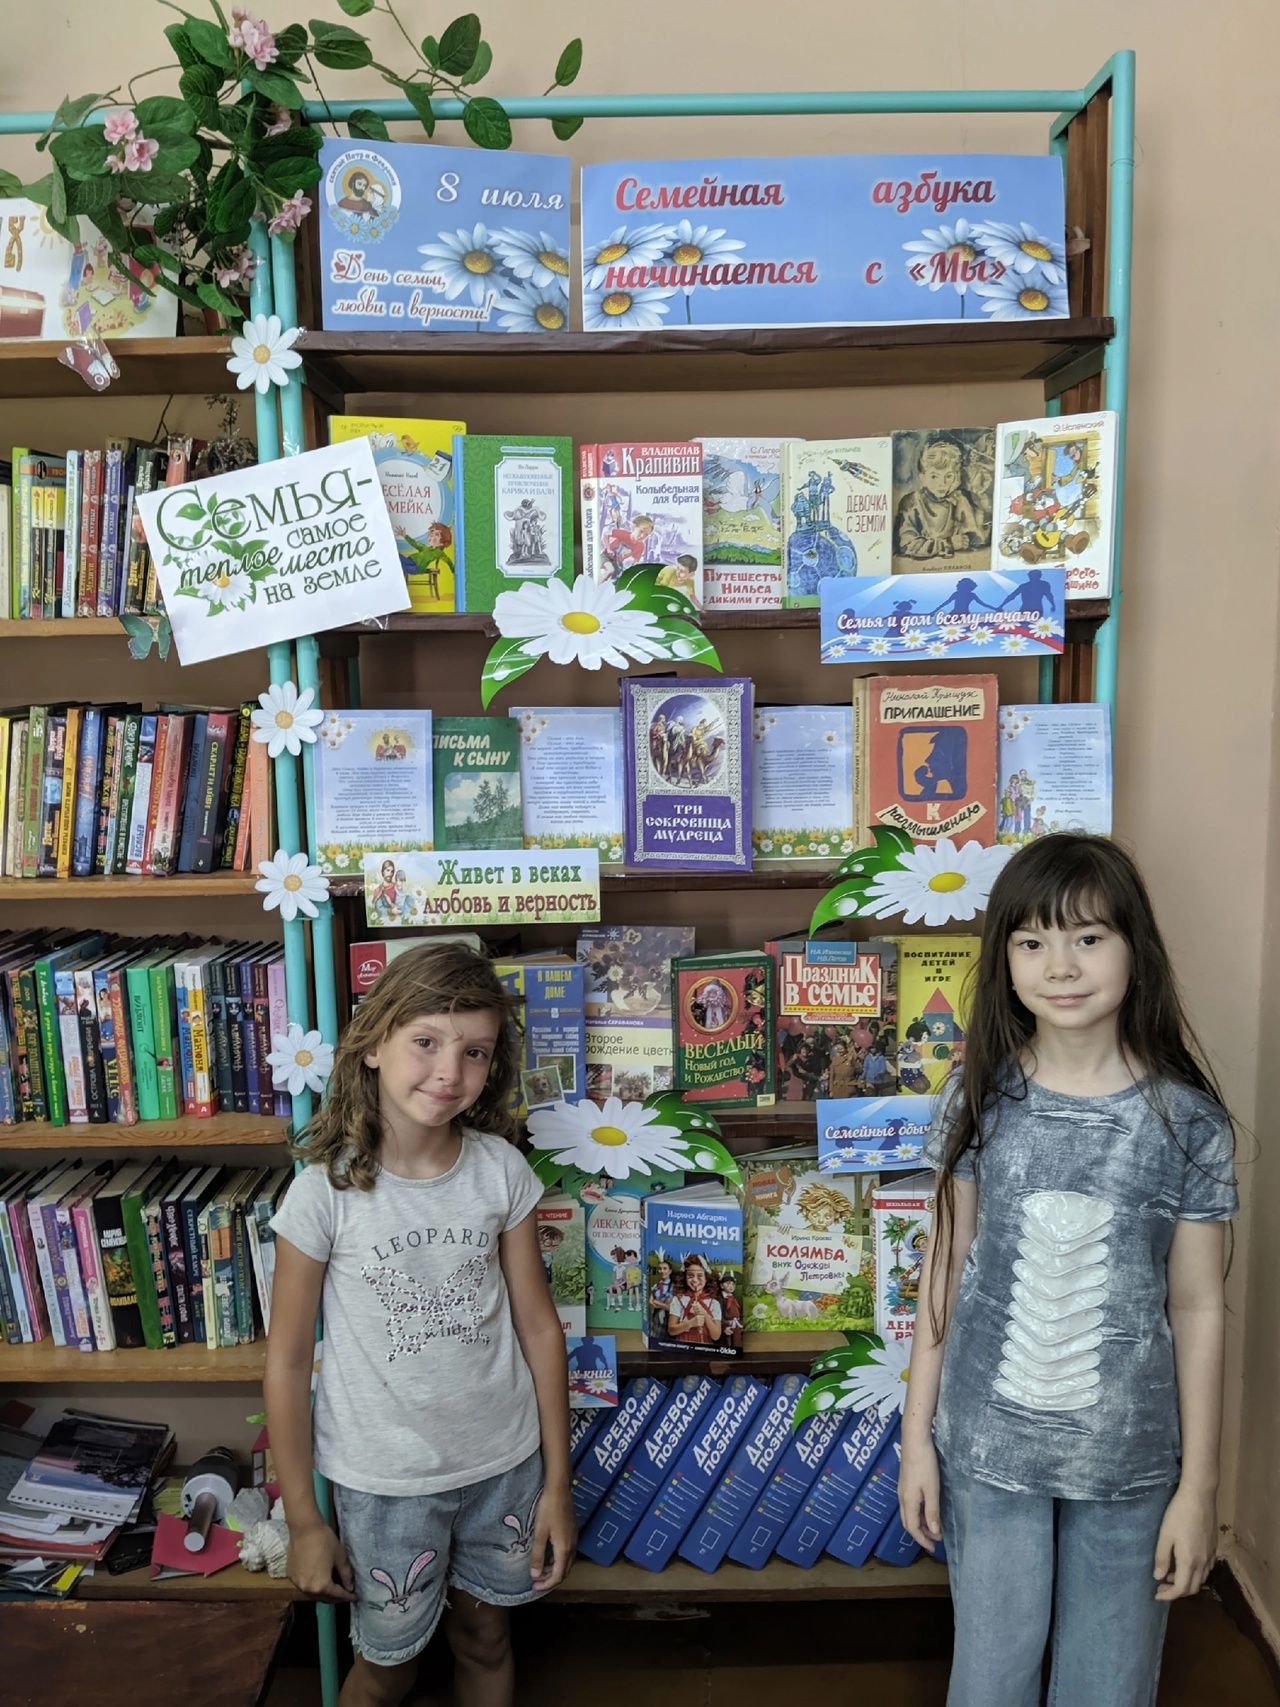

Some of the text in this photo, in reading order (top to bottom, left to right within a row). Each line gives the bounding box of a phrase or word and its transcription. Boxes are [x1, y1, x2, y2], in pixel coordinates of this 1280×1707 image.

[436, 172, 564, 210] 8 июля
[615, 170, 995, 213] Семейная азбука
[333, 252, 446, 288] День семьи,
[604, 251, 1007, 288] начинается с «Мы»
[334, 289, 493, 324] любви и верности!
[641, 446, 700, 456] ВЛАДИСЛАВ
[622, 447, 700, 482] Крапивин
[382, 484, 431, 498] ЕСЁЛАЯ
[636, 484, 699, 495] Колыбельная
[652, 493, 700, 506] для брата
[387, 499, 433, 515] МЕЙКА
[846, 495, 888, 513] ДЕВОЧКА
[287, 513, 367, 549] самое
[846, 514, 886, 533] С ЗЕМЛИ
[180, 546, 282, 589] теплое
[279, 536, 375, 577] место
[264, 559, 382, 605] на земле
[703, 568, 782, 582] ПУТЕШЕСТВ
[838, 609, 1040, 633] Семья и дом всему начало
[884, 704, 981, 719] ПРИГЛАШЕНИЕ
[454, 751, 511, 767] К СЫНУ
[674, 805, 703, 815] ТРИ
[927, 803, 941, 820] К
[646, 817, 732, 831] СОКРОВИЩА
[653, 830, 724, 843] МУДРЕЦА
[438, 859, 582, 885] Живет в веках
[423, 889, 597, 921] любовь и верность
[545, 969, 572, 982] ВАШЕМ
[545, 986, 566, 1000] ДОМЕ
[785, 983, 875, 1006] в семье
[825, 1123, 896, 1140] Семейные
[592, 1219, 640, 1230] ЛЕКАРСТ
[602, 1232, 640, 1240] ПОСЛУШНО
[657, 1220, 740, 1242] МАНЮНЯ
[371, 1228, 489, 1262] LEOPARD
[766, 1244, 848, 1263] КОЛЯМБА,
[425, 1324, 463, 1339] wild
[584, 1369, 614, 1379] книг
[594, 1397, 638, 1467] ДРЕВО
[604, 1383, 661, 1474] ПОЗНАНИЯ
[644, 1392, 688, 1461] ДРЕВО
[655, 1379, 712, 1470] ПОЗНАНИЯ
[693, 1397, 736, 1468] ДРЕВО
[702, 1384, 759, 1476] ПОЗНАНИЯ
[745, 1396, 788, 1466] ДРЕВО
[842, 1403, 879, 1464] ДРЕВ
[795, 1411, 831, 1462] ДРЕВ
[806, 1409, 846, 1470] ПОЗНА
[853, 1411, 893, 1472] ПОЗНА
